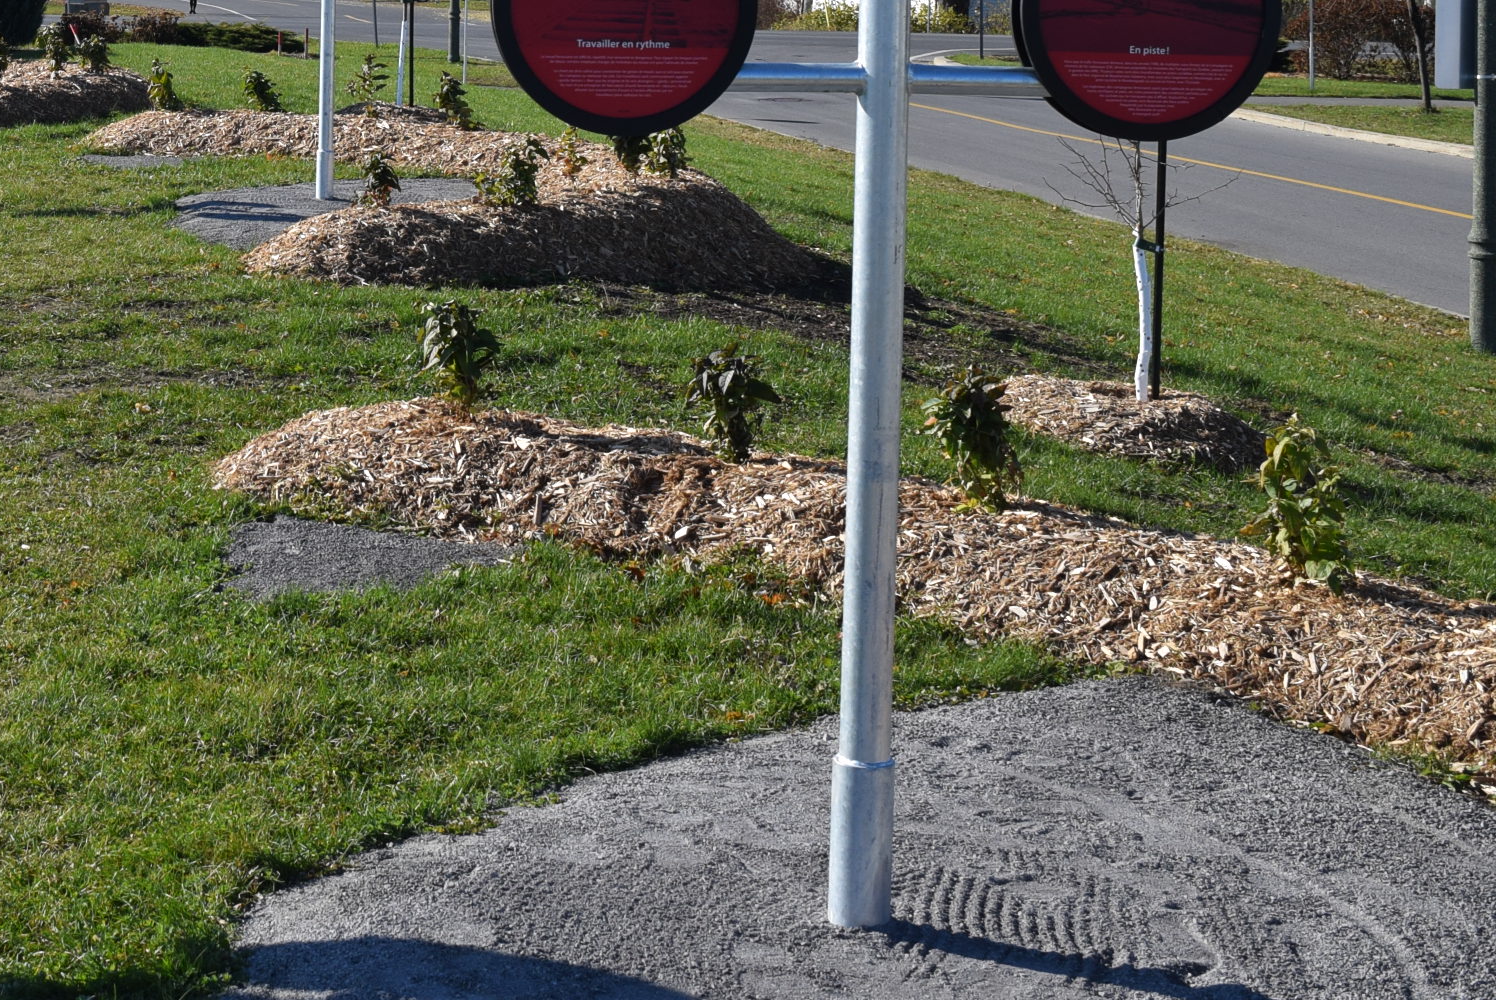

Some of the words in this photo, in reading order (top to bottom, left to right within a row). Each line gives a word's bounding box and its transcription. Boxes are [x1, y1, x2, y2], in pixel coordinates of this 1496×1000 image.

[576, 39, 620, 48] Travailler
[635, 40, 670, 51] rythme
[1129, 46, 1141, 54] En
